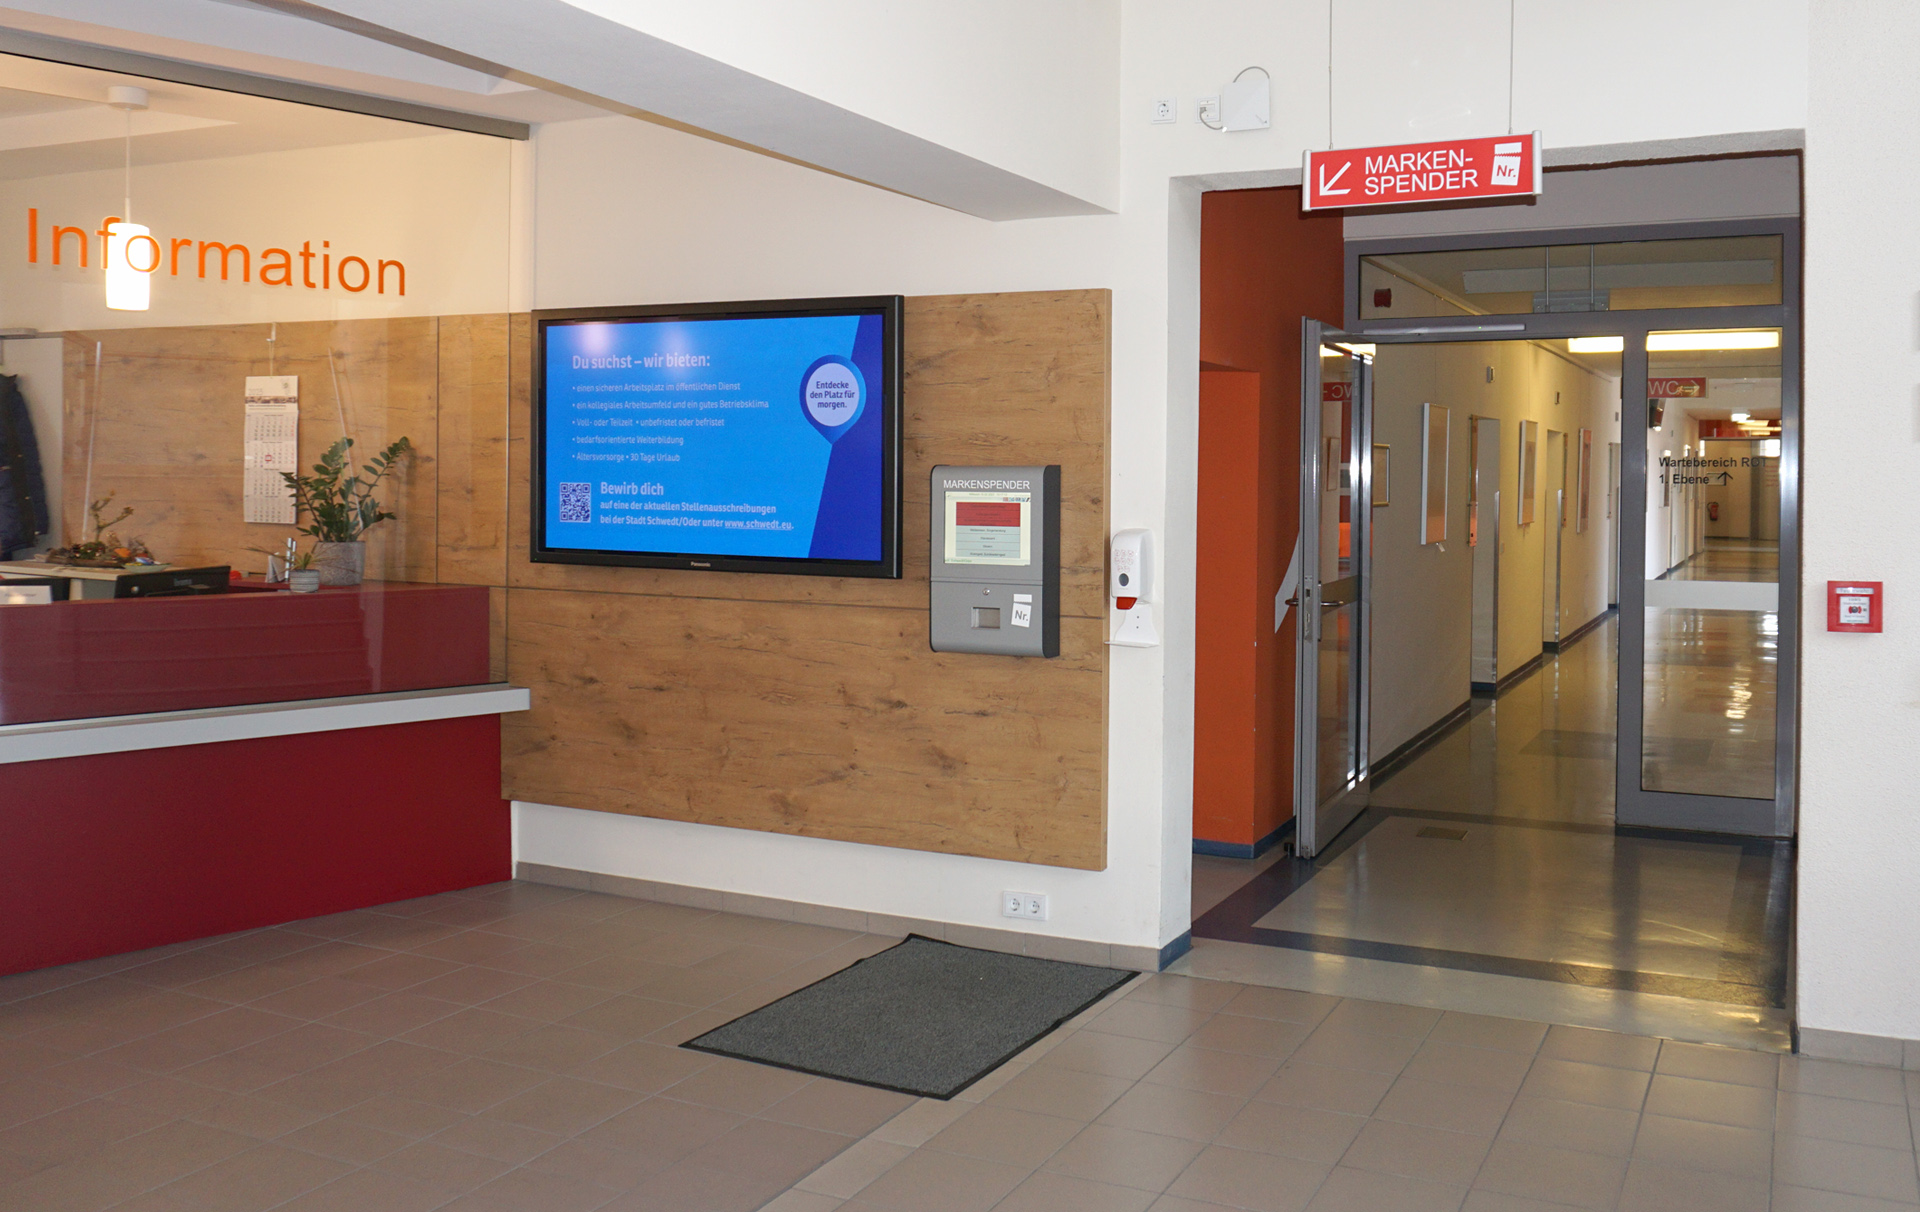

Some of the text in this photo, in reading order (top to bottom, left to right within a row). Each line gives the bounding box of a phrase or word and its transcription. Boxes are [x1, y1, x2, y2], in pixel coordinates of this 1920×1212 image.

[1365, 149, 1473, 174] MARKEN-
[1496, 164, 1516, 178] Nr.
[1364, 169, 1479, 196] SPENDER
[27, 207, 405, 296] Information
[572, 355, 589, 369] Du
[591, 355, 632, 369] suchst
[643, 353, 664, 368] wir
[666, 352, 710, 367] bieten:
[595, 384, 622, 392] sicheren
[623, 383, 664, 392] Arbeitsplatz
[718, 381, 741, 391] Dienst
[816, 381, 849, 389] Entdecke
[1648, 380, 1679, 395] WC
[810, 390, 855, 399] den Platz für
[588, 402, 623, 411] kollegiales
[624, 401, 672, 409] Arbeitsumfeld
[673, 400, 686, 409] und
[687, 400, 698, 408] ein
[699, 401, 719, 410] gutes
[719, 400, 769, 408] Betriebsklima
[817, 401, 848, 410] morgen.
[610, 418, 633, 426] Teilzeit
[640, 418, 677, 426] unbefristet
[678, 418, 693, 426] oder
[695, 418, 725, 426] befristet
[576, 436, 684, 446] bedarfsorientierte Weiterbildung
[576, 453, 624, 462] Altersvorsorge
[640, 454, 655, 462] Tage
[1659, 457, 1767, 467] Wartebereich ROT
[943, 480, 1030, 489] MARKENSPENDER
[1659, 474, 1710, 484] 1. Ebene
[600, 482, 664, 496] Bewirb dich
[600, 500, 776, 516] auf eine der aktuellen Stellenausschreibungen
[600, 515, 794, 531] bei der Stadt Schwedt/Oder unter www.schwedt.eu.
[1015, 610, 1029, 622] Nr.
